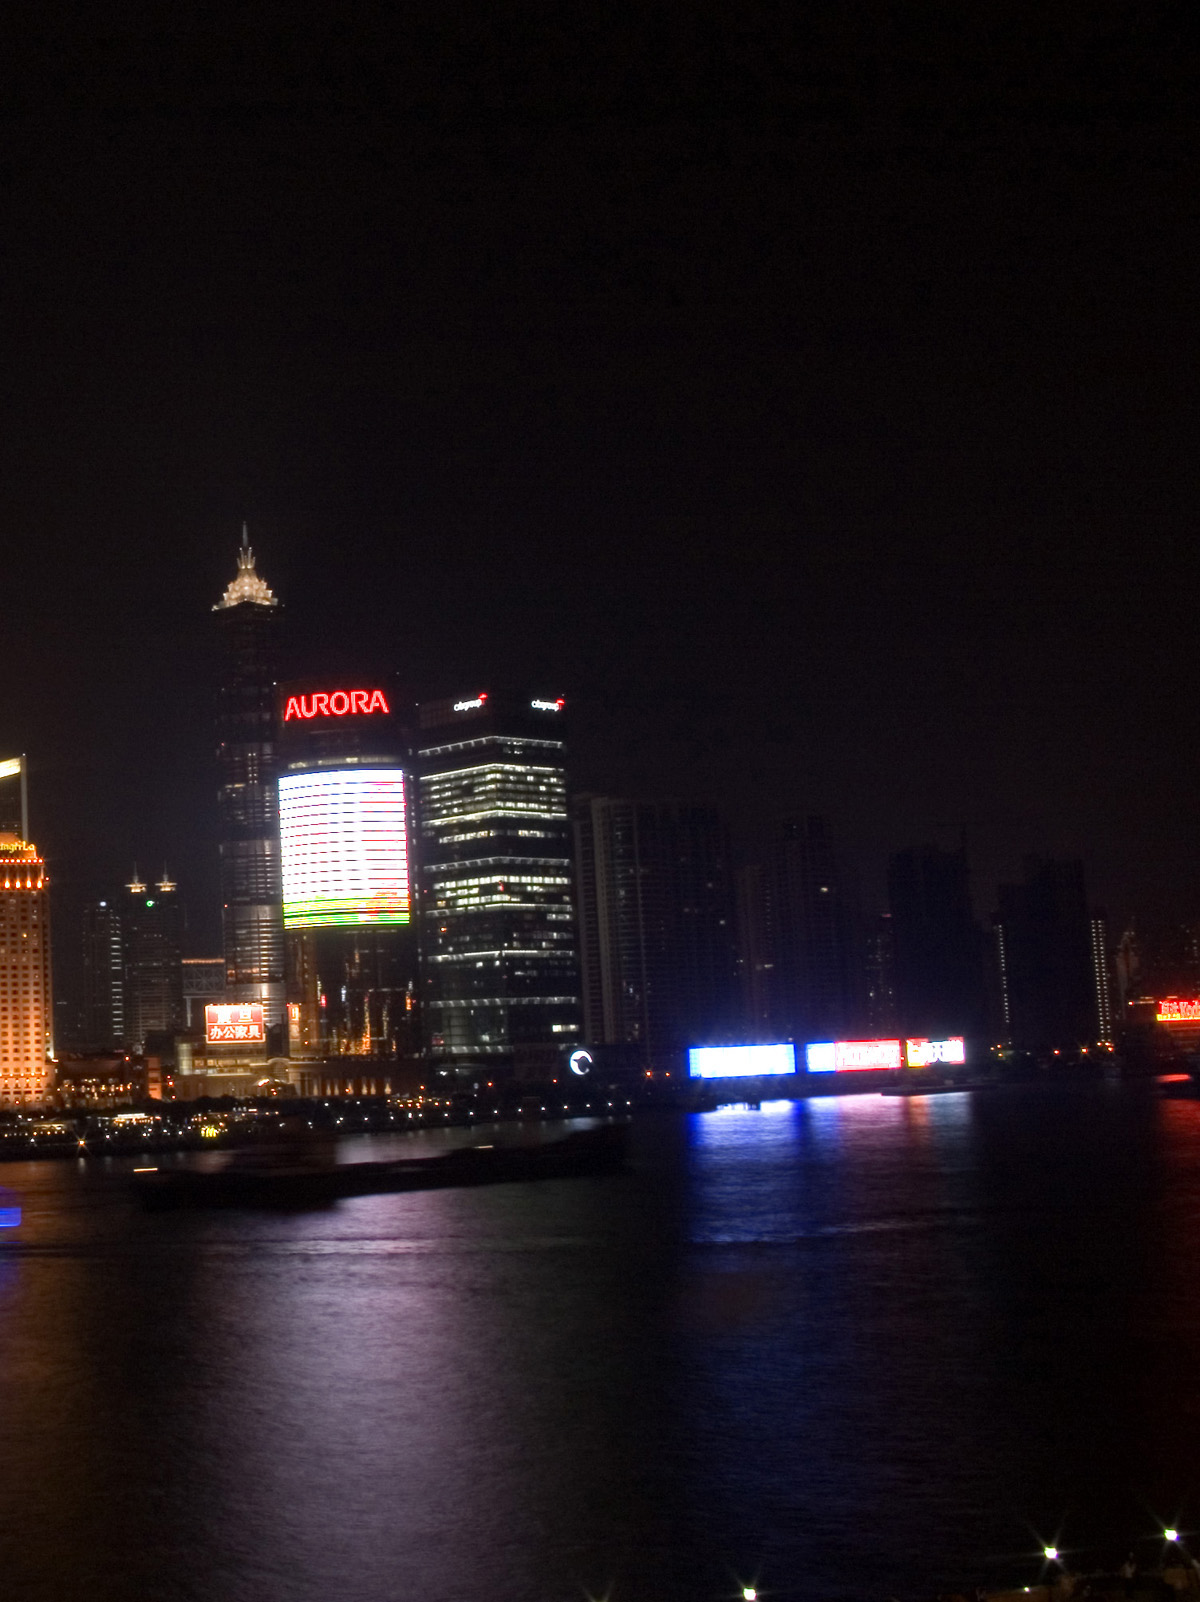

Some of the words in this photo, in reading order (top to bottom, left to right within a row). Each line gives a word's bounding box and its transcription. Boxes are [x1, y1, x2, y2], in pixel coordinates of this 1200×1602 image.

[284, 689, 390, 721] AURORA
[210, 1025, 261, 1040] 办公家具
